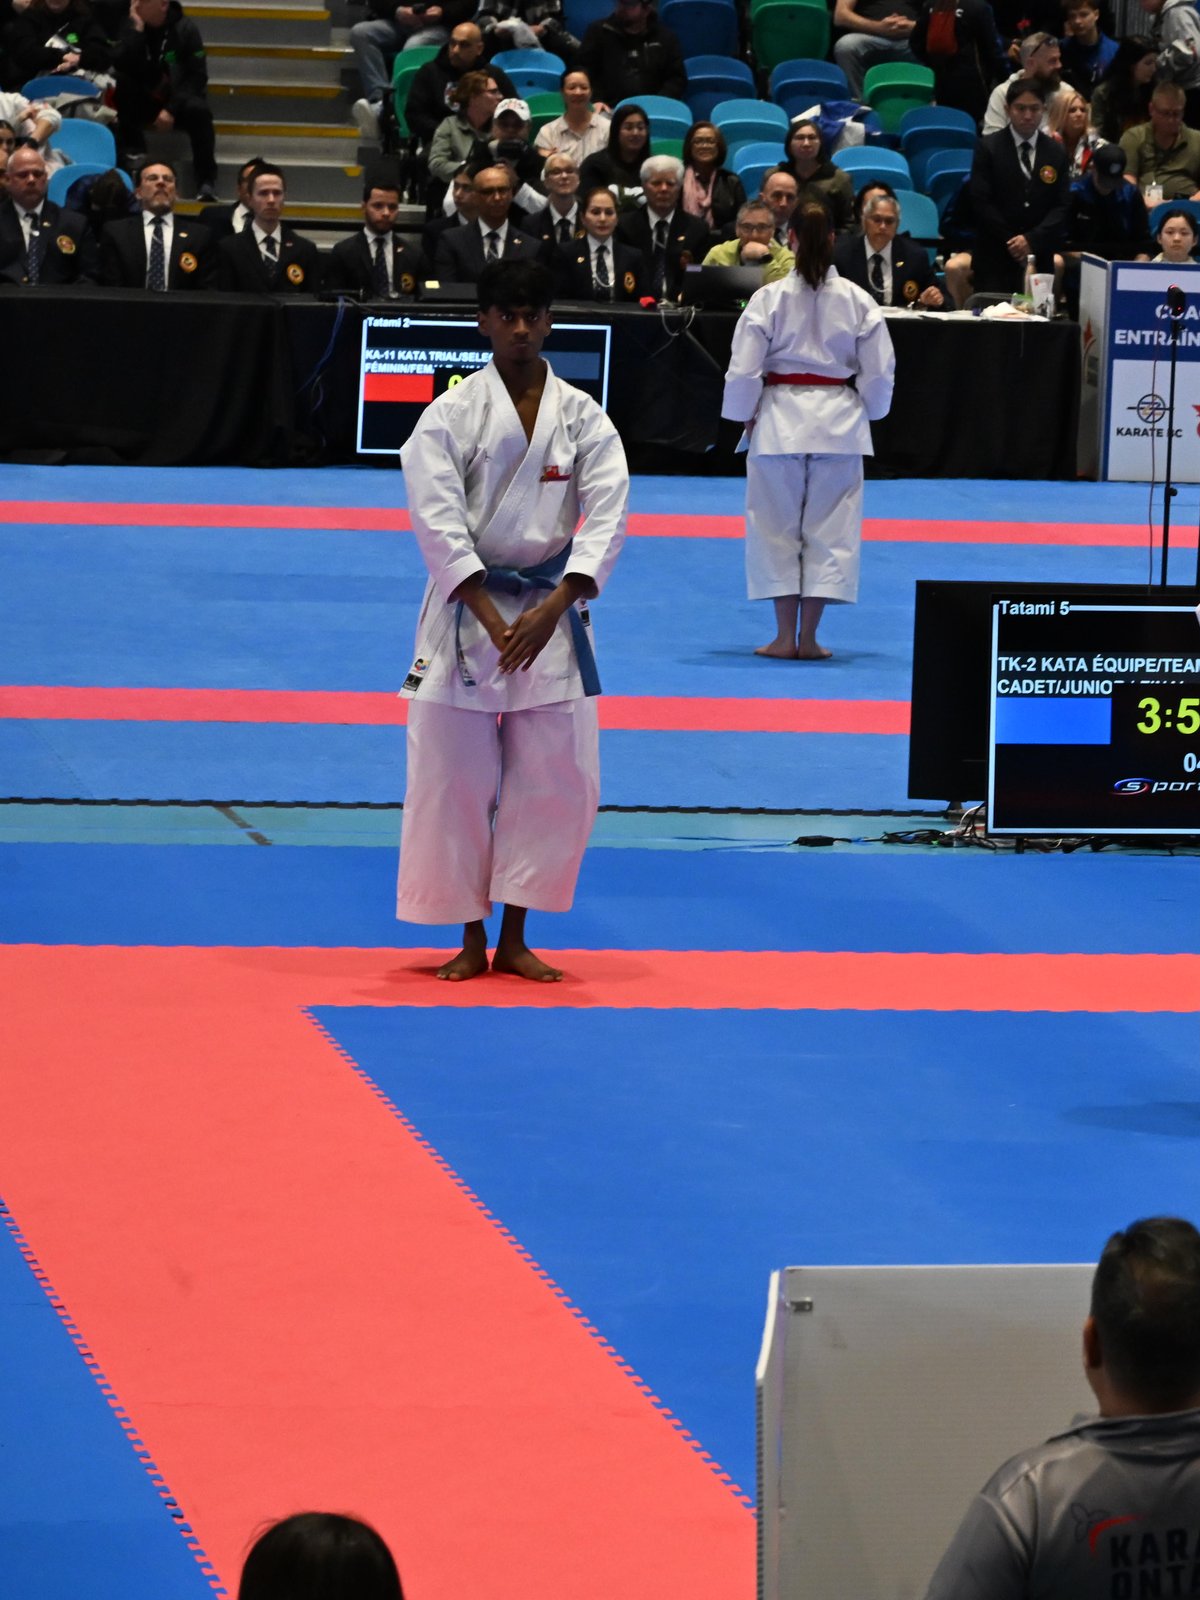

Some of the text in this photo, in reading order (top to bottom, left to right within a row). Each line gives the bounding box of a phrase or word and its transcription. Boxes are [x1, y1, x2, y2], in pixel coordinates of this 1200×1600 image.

[367, 317, 410, 328] Tatami 2
[365, 350, 395, 359] KA-11
[398, 350, 427, 360] KATA
[1116, 427, 1164, 438] KARATE
[999, 600, 1070, 615] Tatami 5
[998, 657, 1037, 671] TK-2
[1041, 657, 1088, 672] KATA
[997, 679, 1125, 695] CADET/JUNIO
